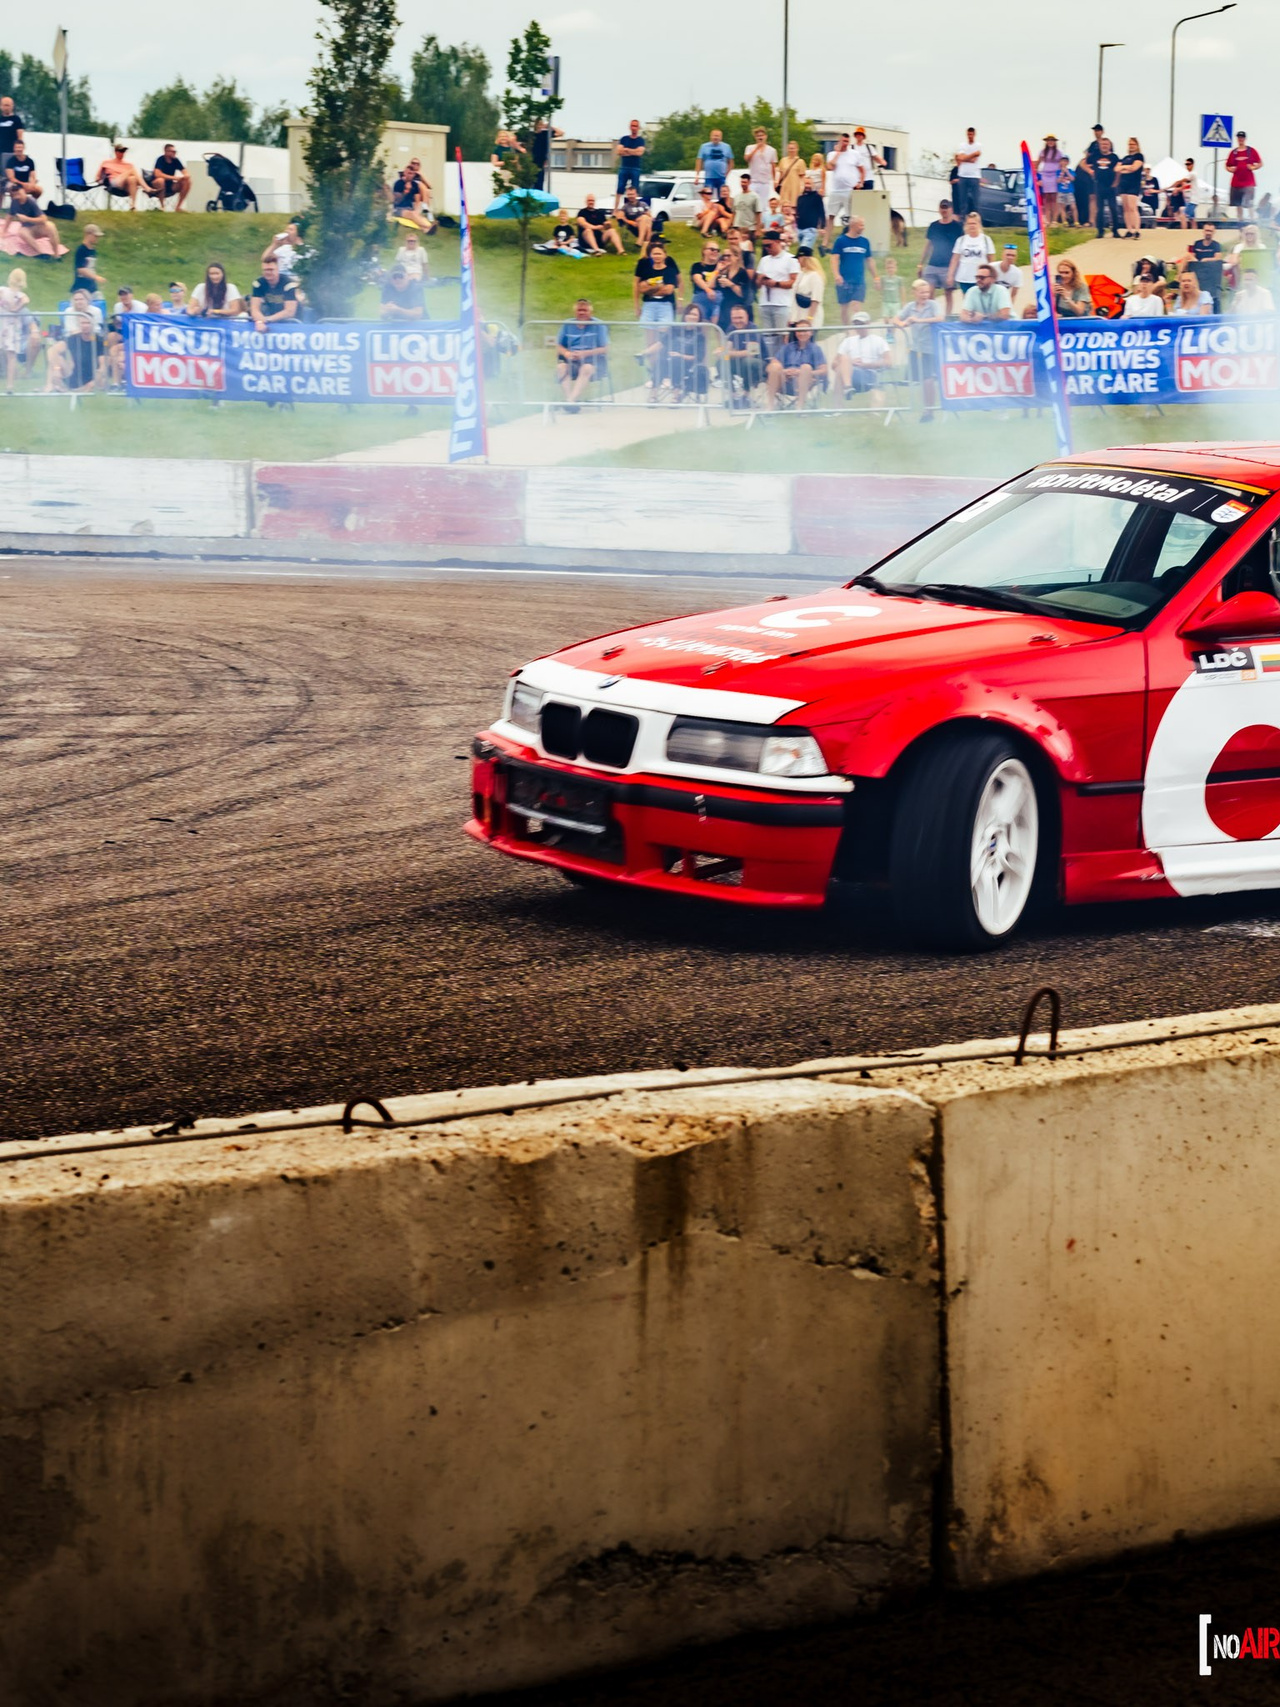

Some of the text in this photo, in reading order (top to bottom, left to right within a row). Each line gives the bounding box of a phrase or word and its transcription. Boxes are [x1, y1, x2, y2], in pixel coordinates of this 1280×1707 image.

[134, 324, 220, 355] LIQUI
[231, 330, 360, 351] MOTOR OILS
[373, 333, 460, 362] LIQUI
[944, 333, 1030, 362] LIQUI
[1059, 329, 1171, 349] OTOR OILS
[1181, 322, 1278, 354] LIQUI
[134, 356, 218, 388] MOLY
[238, 352, 352, 373] ADDITIVES
[1062, 350, 1161, 371] DDITIVES
[1179, 356, 1278, 388] MOLY
[242, 374, 351, 395] CAR CARE
[947, 365, 1028, 395] MOLY
[1065, 373, 1159, 394] AR CARE
